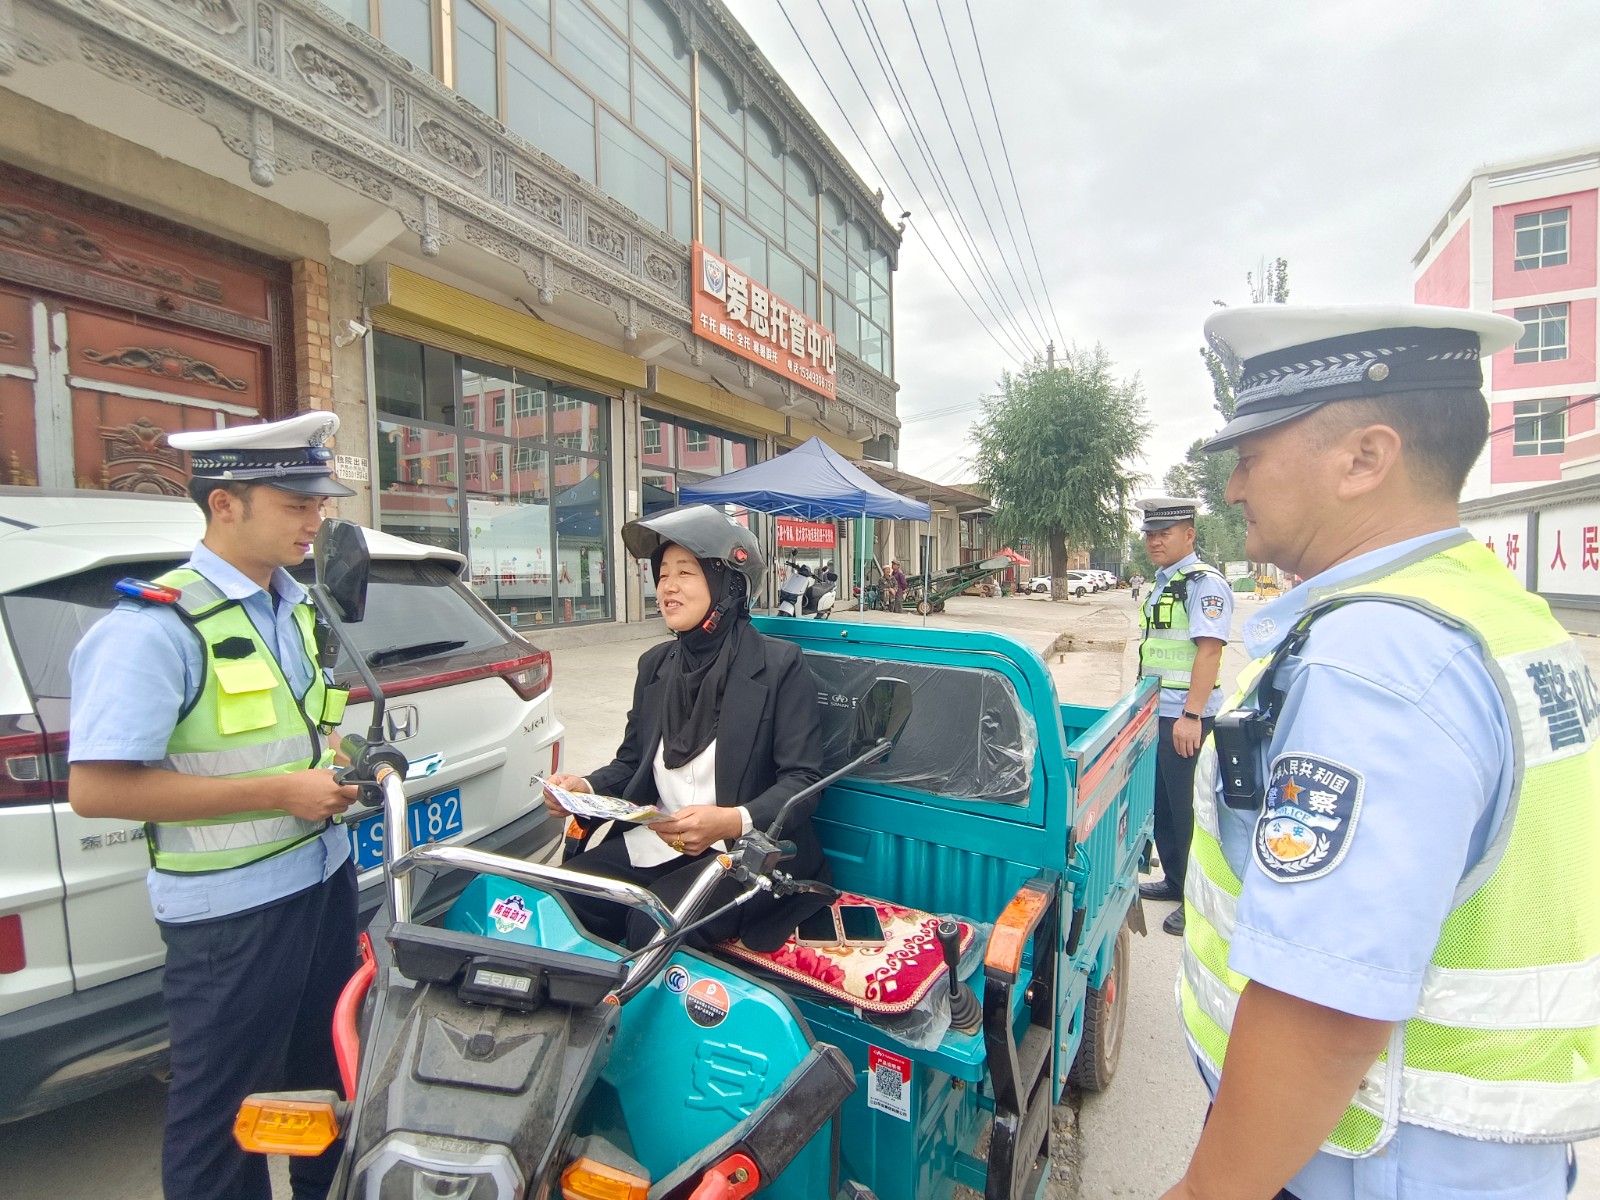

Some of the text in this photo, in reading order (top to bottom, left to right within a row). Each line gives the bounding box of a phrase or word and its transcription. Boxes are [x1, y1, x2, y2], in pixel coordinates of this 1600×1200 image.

[700, 312, 717, 334] 午托
[736, 333, 751, 350] 全托
[726, 267, 836, 375] 爱思托管中心
[1551, 526, 1599, 571] 人民
[1149, 647, 1194, 661] POLICE
[1308, 790, 1338, 816] 察
[1292, 825, 1304, 838] 安
